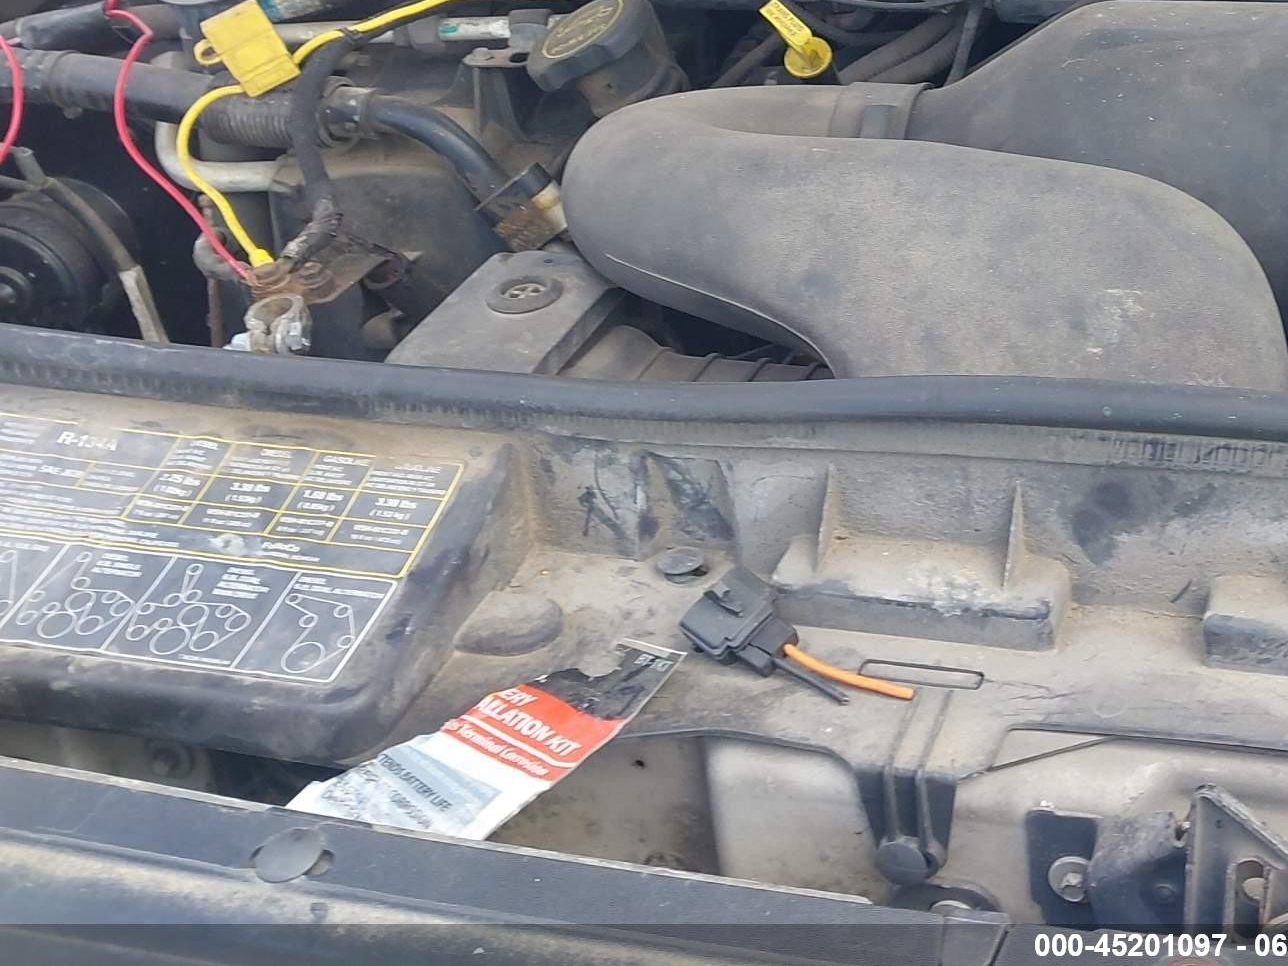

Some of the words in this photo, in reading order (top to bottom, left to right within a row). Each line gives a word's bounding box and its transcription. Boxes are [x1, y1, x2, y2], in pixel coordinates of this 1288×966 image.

[56, 431, 118, 451] R-134A
[456, 723, 503, 755] Terminal
[499, 745, 550, 776] Corrosion
[545, 734, 582, 756] KIT
[399, 771, 437, 798] BATTERY
[429, 792, 454, 812] LIFE
